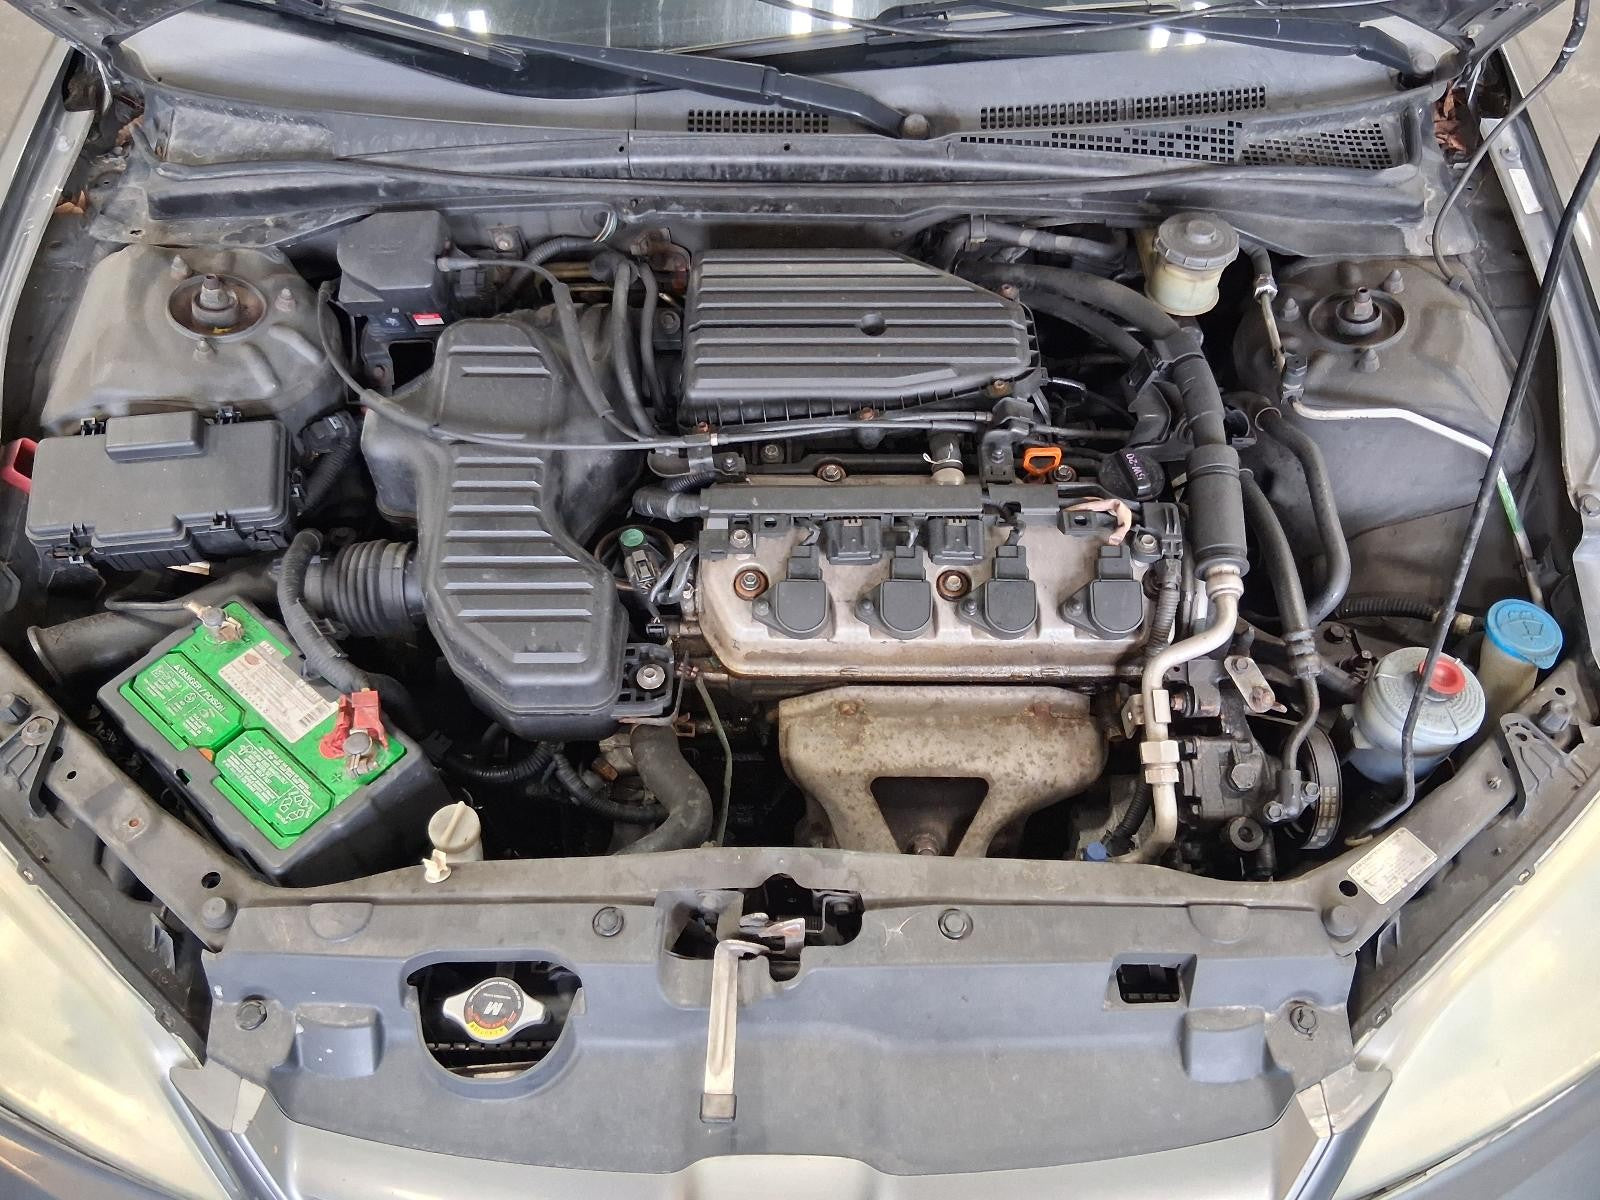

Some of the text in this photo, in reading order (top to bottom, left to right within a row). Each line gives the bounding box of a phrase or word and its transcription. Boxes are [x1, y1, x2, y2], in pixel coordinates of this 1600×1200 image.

[1125, 453, 1146, 481] 5W-20
[178, 666, 202, 691] DANGER
[203, 690, 226, 713] POISON
